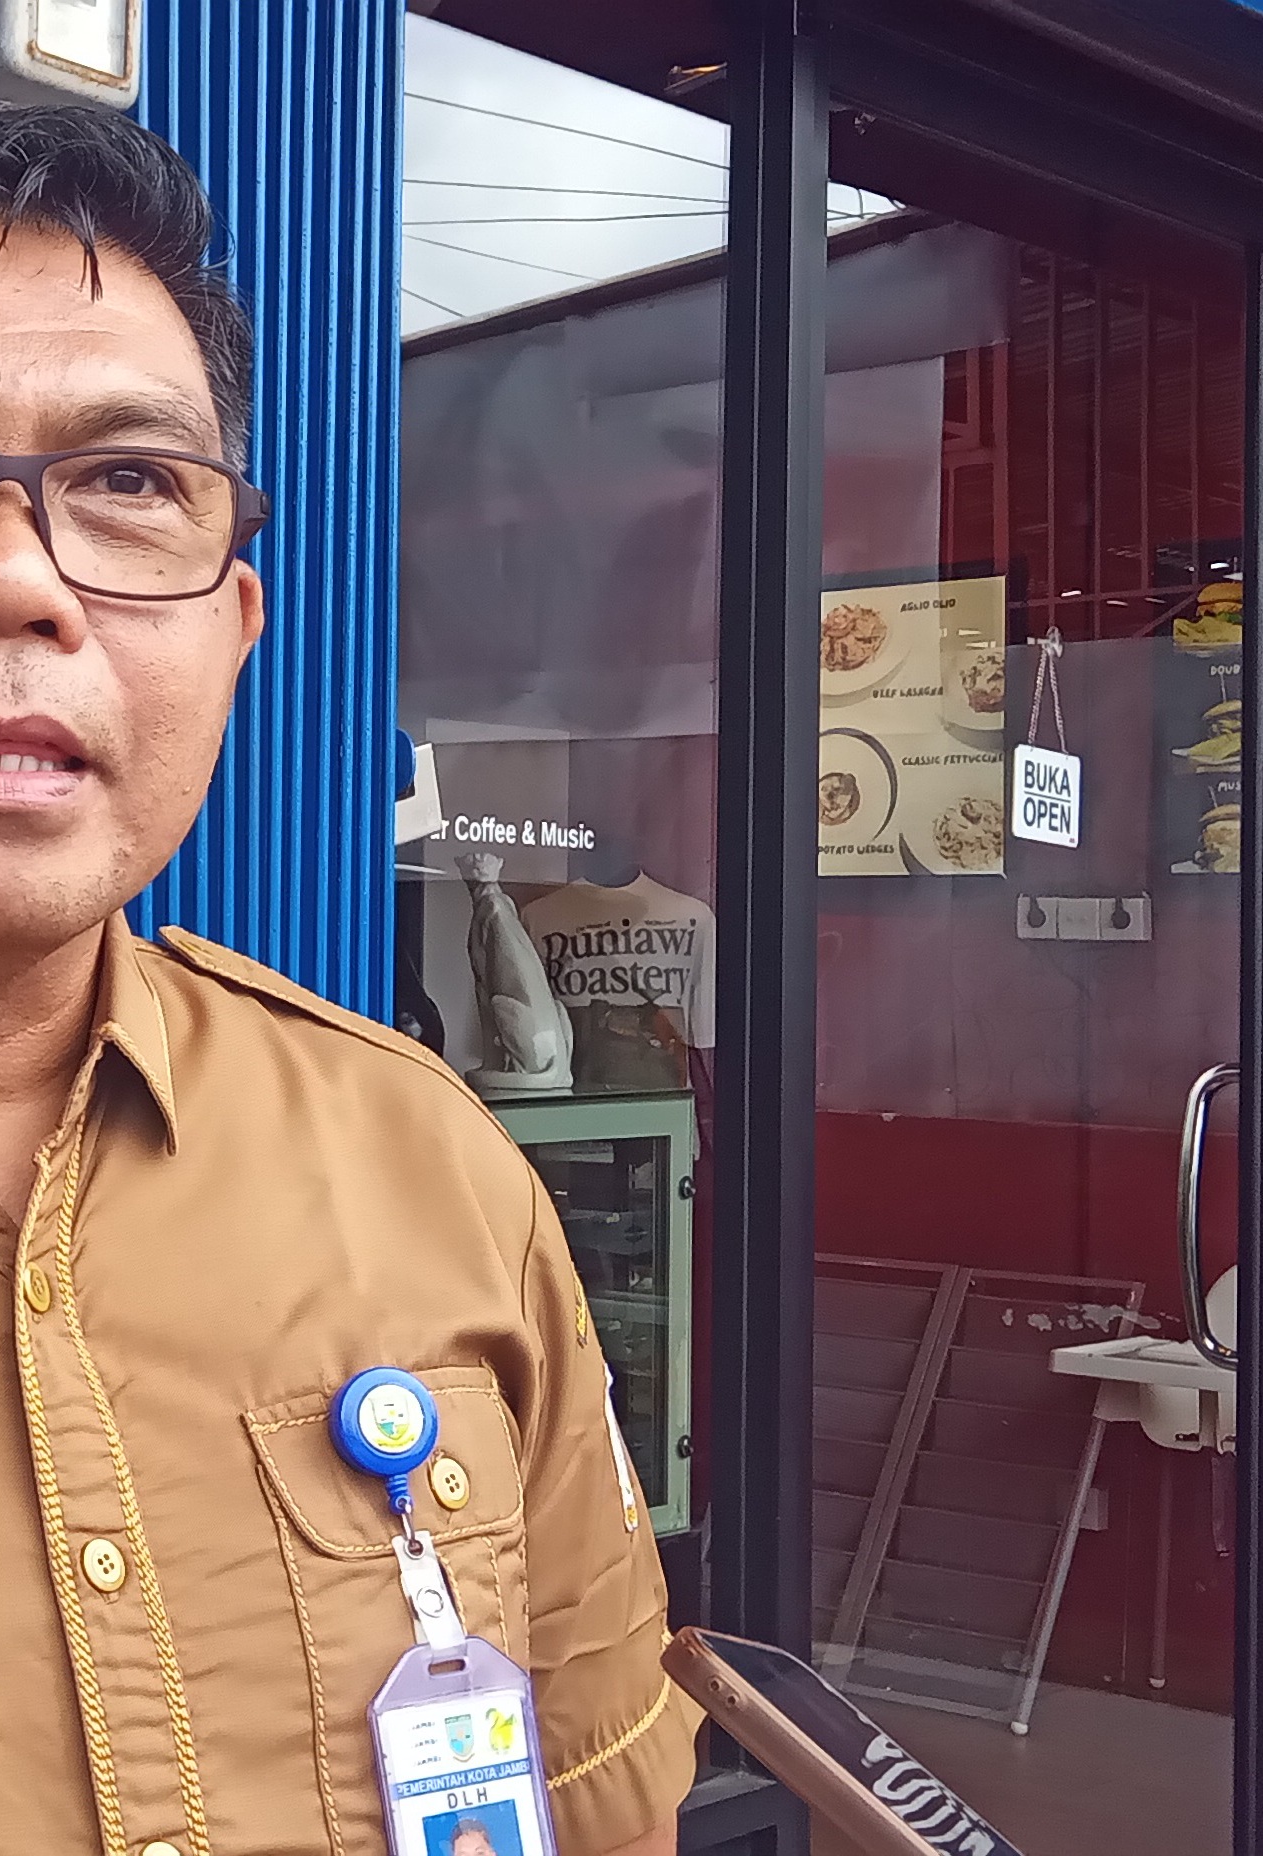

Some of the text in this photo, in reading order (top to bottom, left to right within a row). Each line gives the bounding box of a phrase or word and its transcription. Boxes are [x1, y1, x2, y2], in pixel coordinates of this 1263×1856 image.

[933, 598, 956, 609] OLIO
[901, 754, 940, 766] CLASSIC
[1024, 759, 1072, 798] BUKA
[454, 815, 517, 844] Coffee
[521, 819, 536, 846] &
[540, 821, 595, 849] Music
[1023, 796, 1072, 835] OPEN
[541, 918, 697, 961] Duniawi
[548, 959, 691, 1004] Roastery
[397, 1773, 467, 1796] PEMERINTAH
[468, 1767, 498, 1783] KOTA
